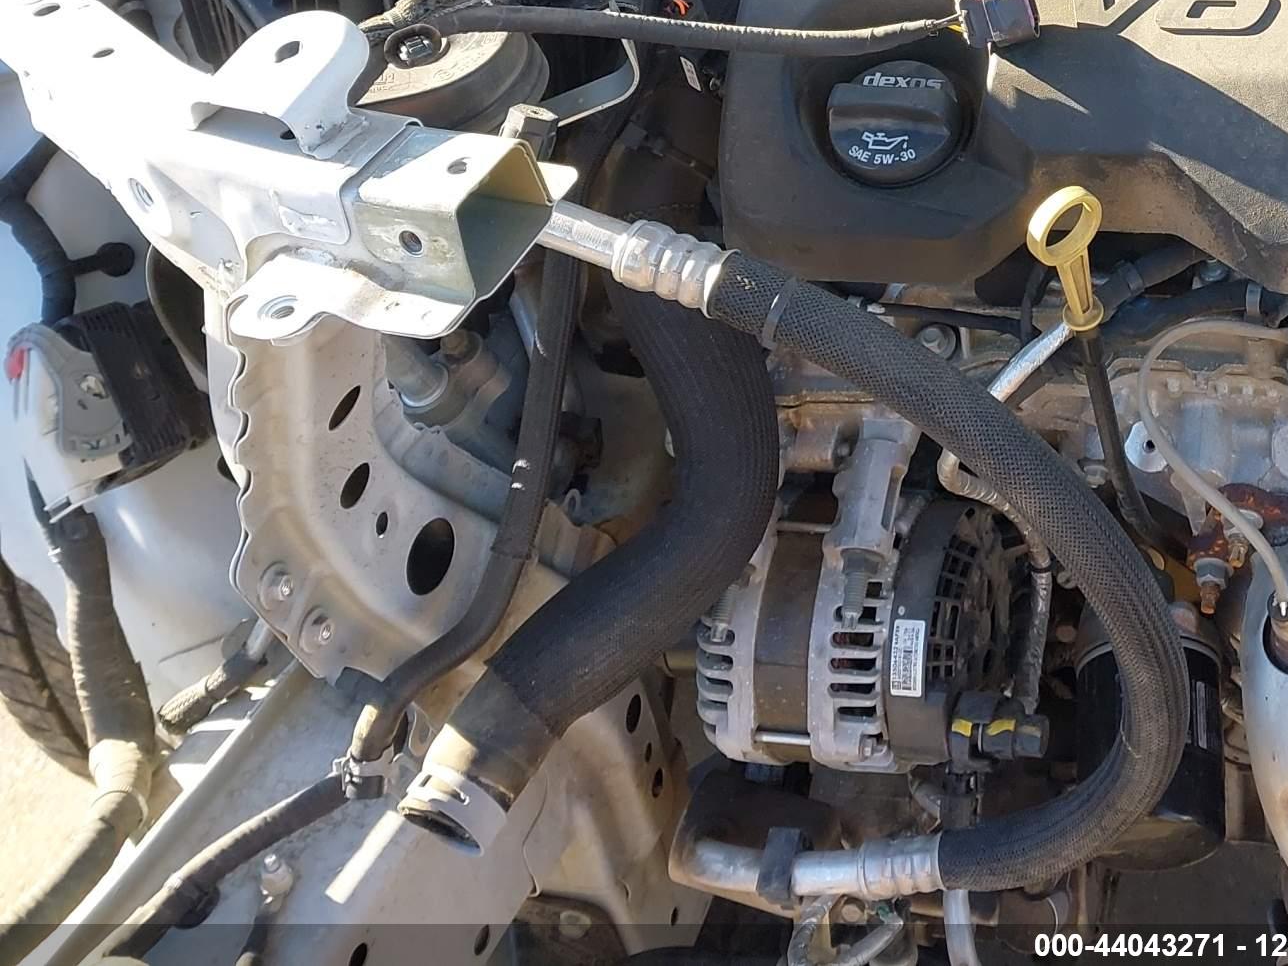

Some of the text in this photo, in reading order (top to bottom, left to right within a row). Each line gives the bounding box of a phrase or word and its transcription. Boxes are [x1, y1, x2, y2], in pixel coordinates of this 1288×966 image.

[863, 72, 945, 90] dexos
[848, 145, 916, 165] SAE 5W-30
